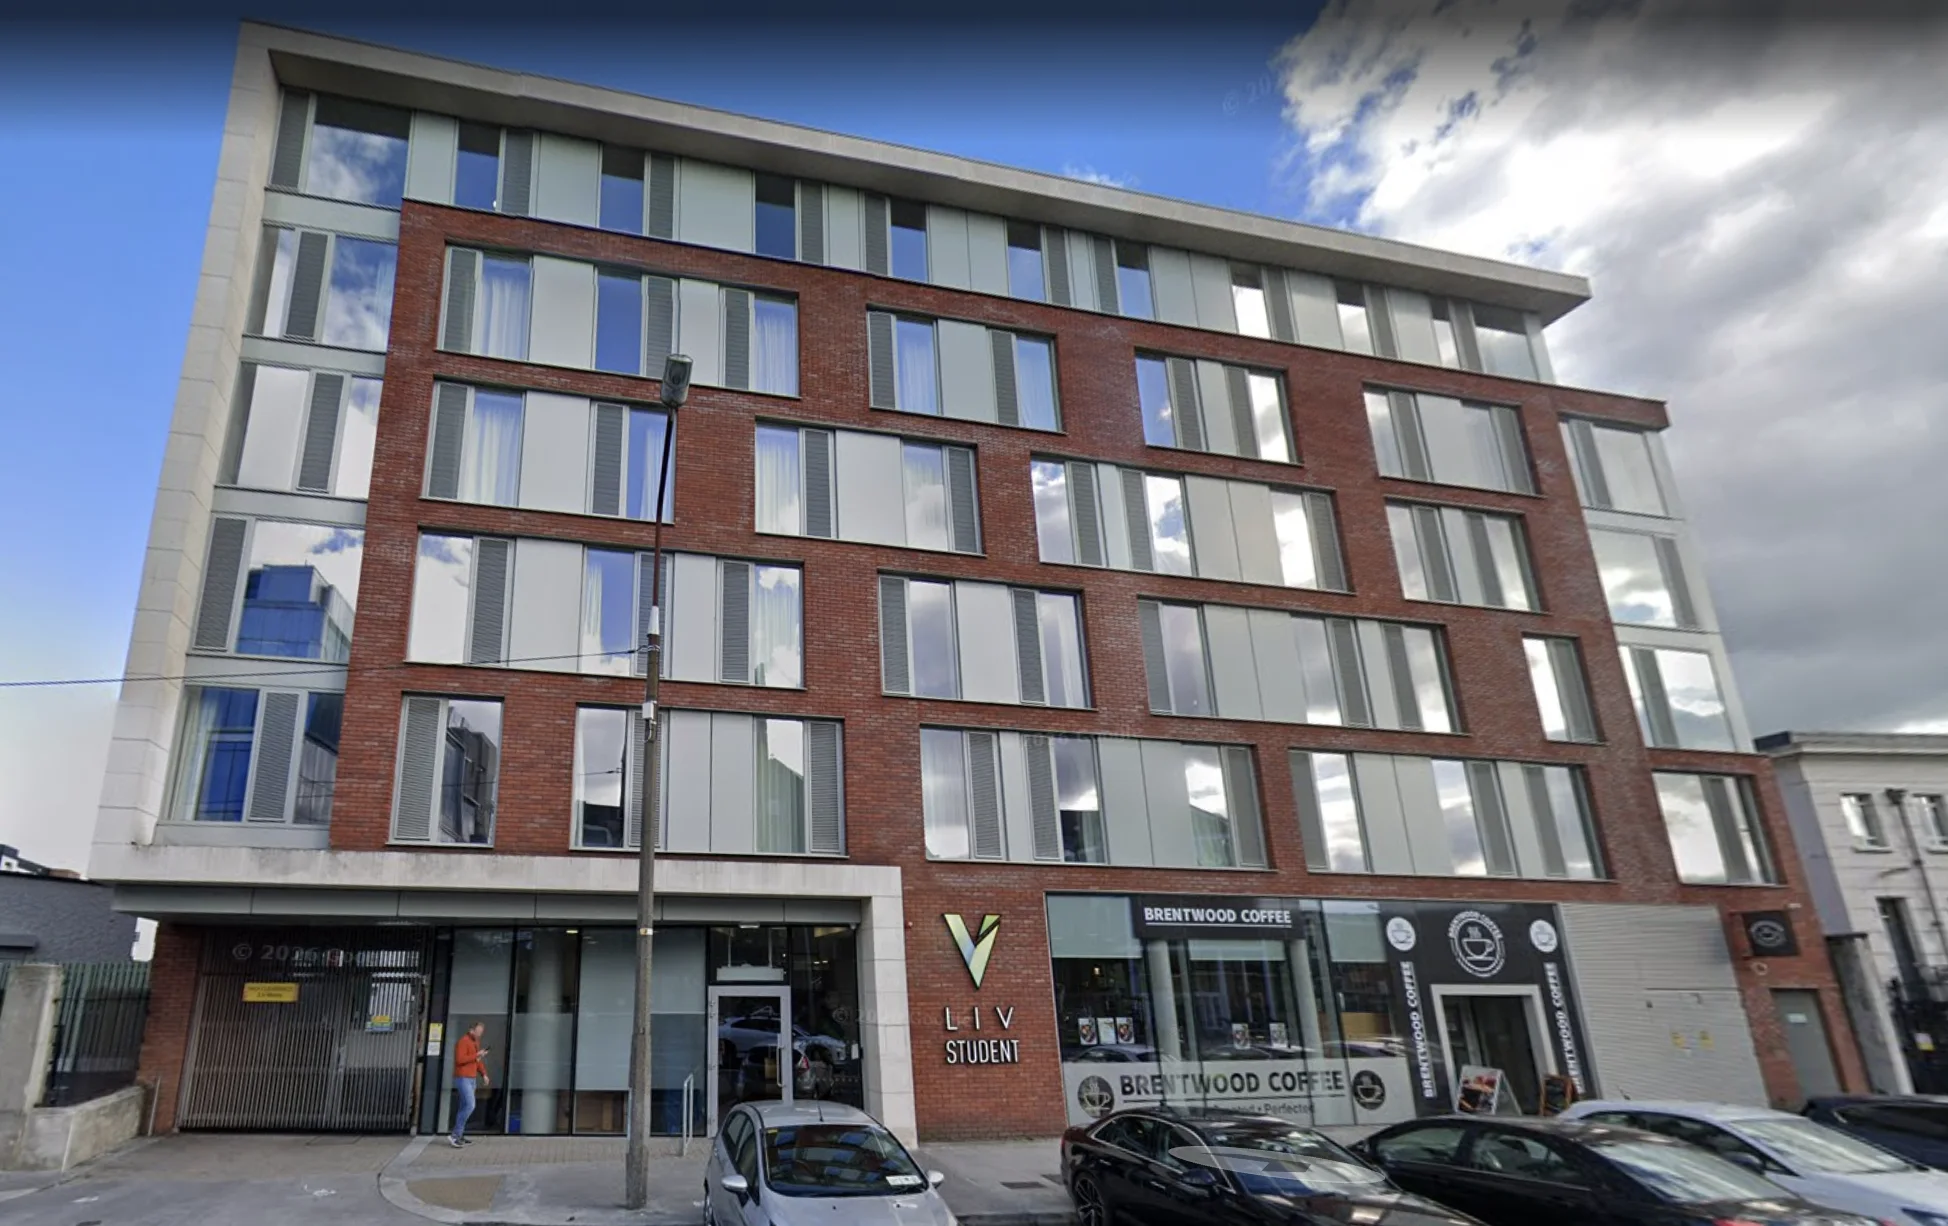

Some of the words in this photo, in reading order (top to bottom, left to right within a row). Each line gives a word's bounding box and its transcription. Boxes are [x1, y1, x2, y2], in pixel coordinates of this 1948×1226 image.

[1144, 907, 1237, 922] BRENTWOOD
[1240, 909, 1292, 924] COFFEE
[1448, 910, 1481, 938] BRENTWOOD
[1481, 914, 1503, 938] COFFEE
[1400, 961, 1421, 1008] COFFEE
[1543, 962, 1564, 1008] COFFEE
[945, 1006, 1014, 1030] LIV
[945, 1039, 1020, 1064] STUDENT
[1410, 1011, 1438, 1098] BRENTWOOD
[1120, 1074, 1259, 1096] BRENTWOOD
[1267, 1070, 1345, 1092] COFFEE
